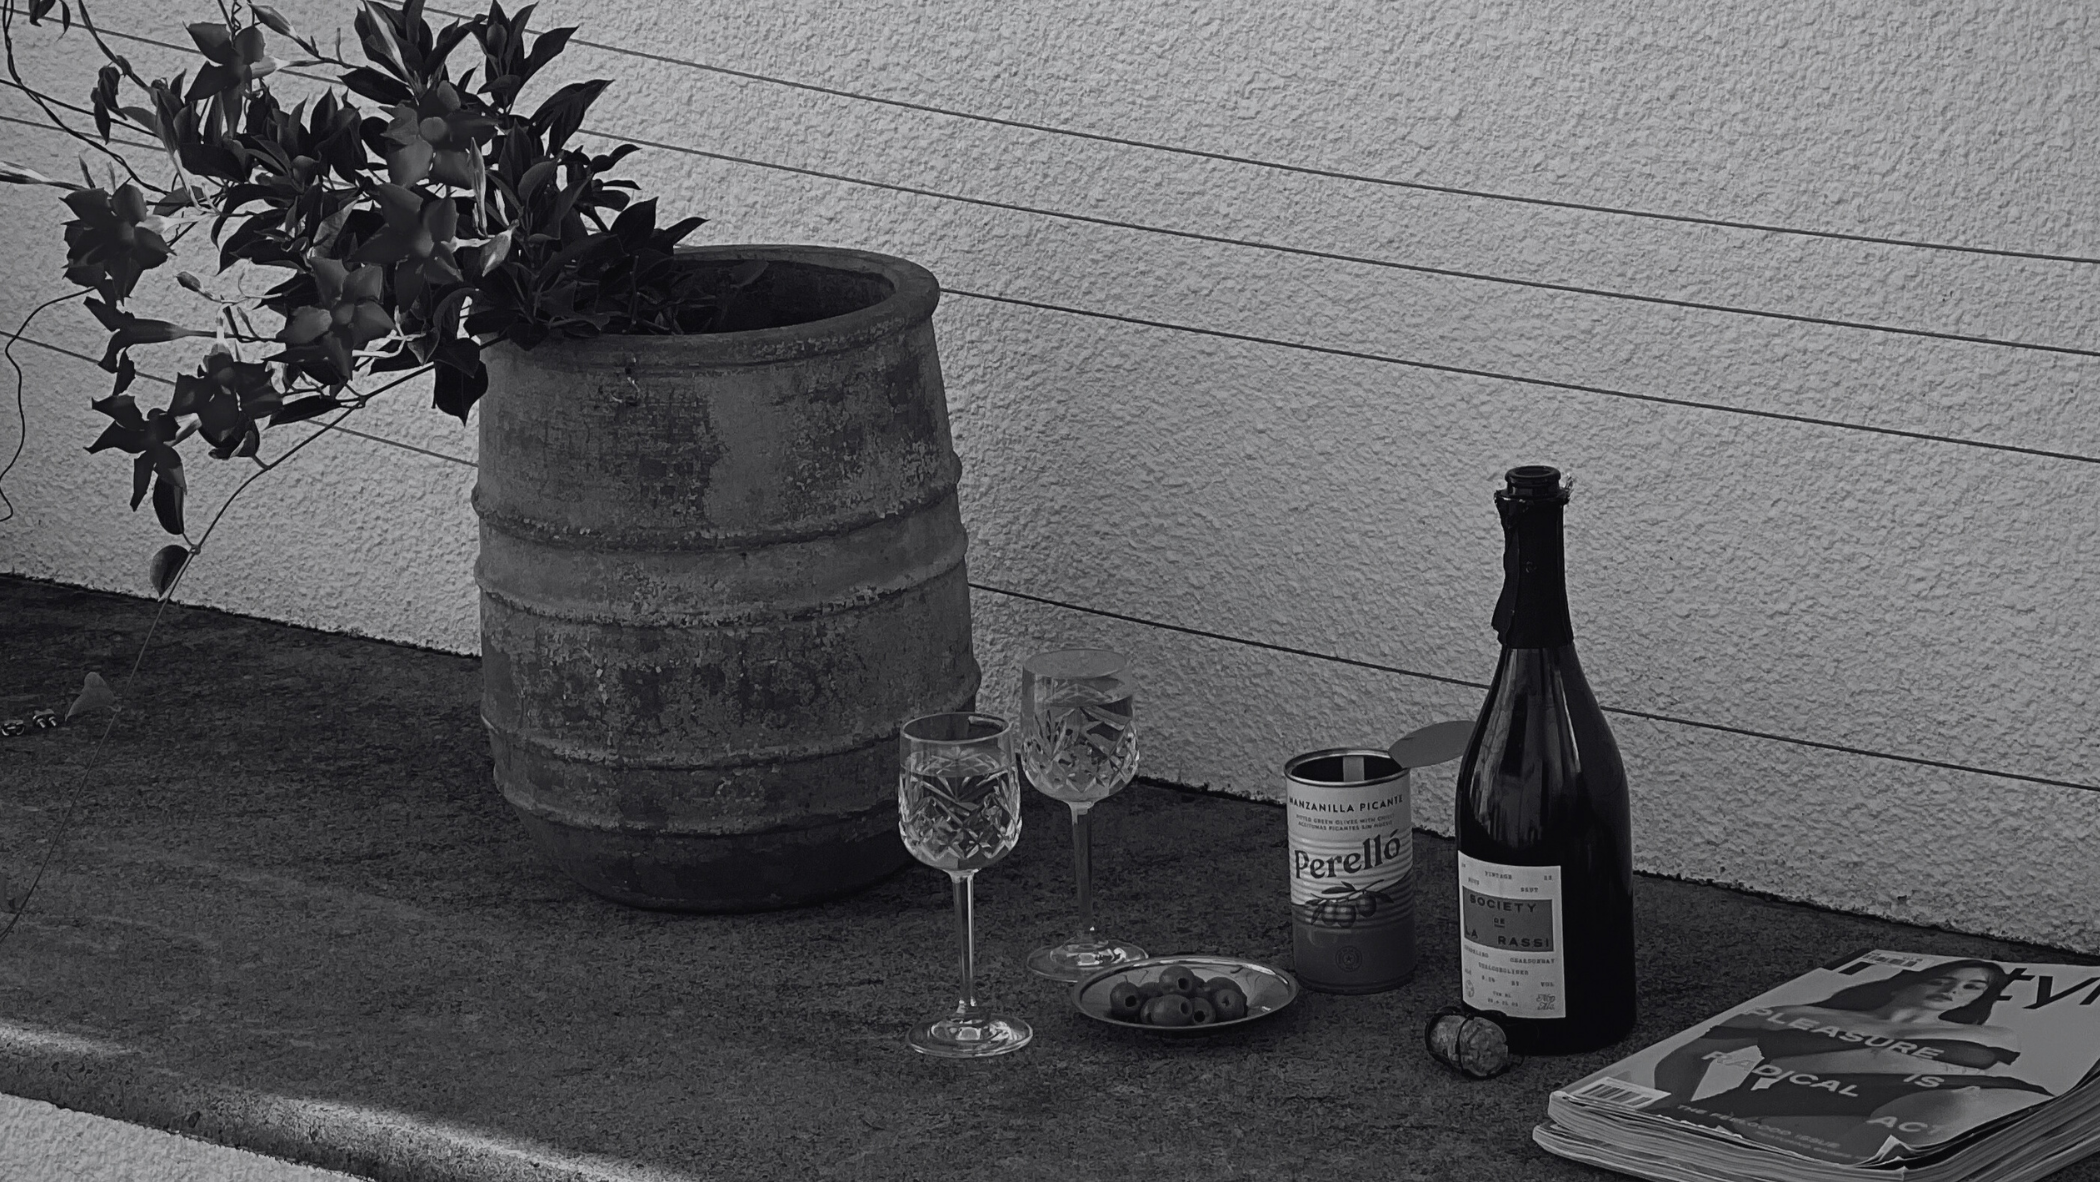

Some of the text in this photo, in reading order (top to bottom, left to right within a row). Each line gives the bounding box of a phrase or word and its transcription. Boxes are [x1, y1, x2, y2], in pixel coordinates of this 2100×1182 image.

[1289, 794, 1403, 813] MANZANILLA PICANTE
[1294, 829, 1401, 879] Perelló
[1484, 870, 1513, 880] VINTAGE
[1469, 894, 1536, 913] SOCIETY
[1465, 925, 1549, 947] LA RASSI
[1741, 1007, 1945, 1060] PLEASURE
[1701, 1050, 1859, 1098] RADICAL
[1903, 1074, 1945, 1088] IS
